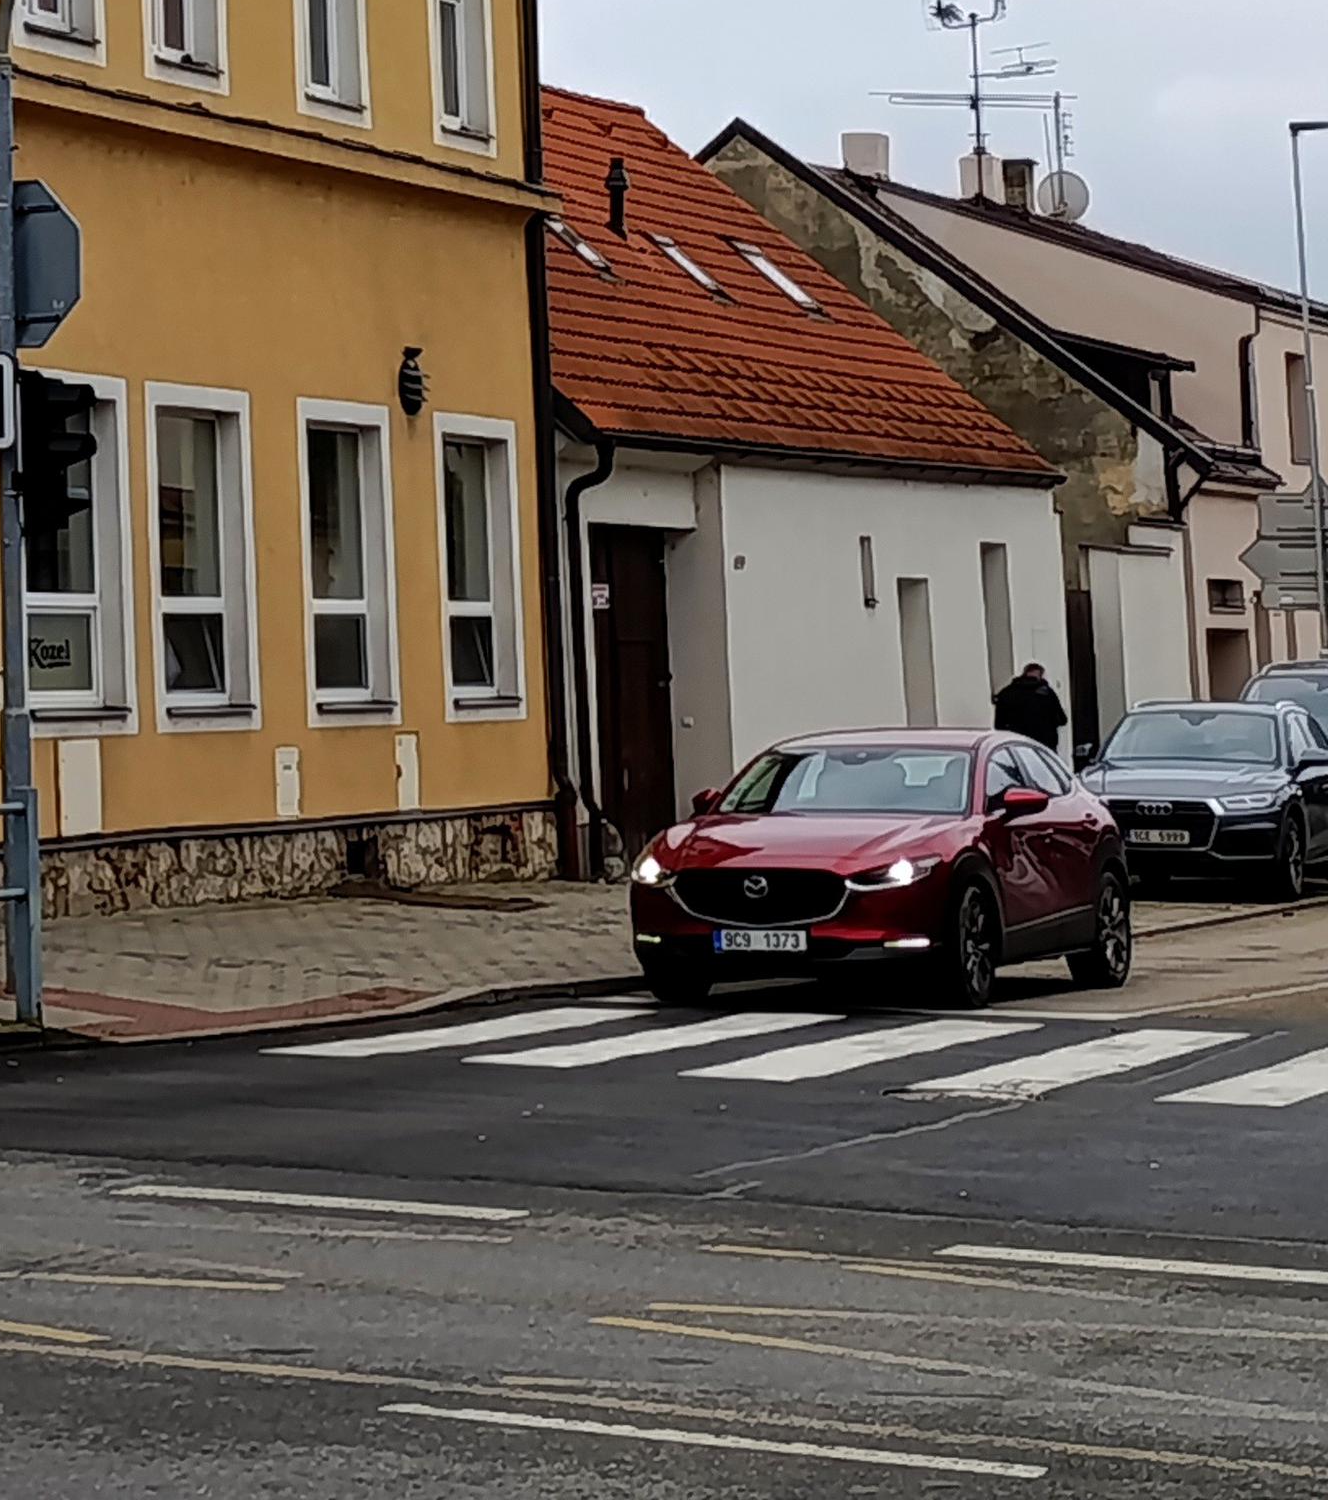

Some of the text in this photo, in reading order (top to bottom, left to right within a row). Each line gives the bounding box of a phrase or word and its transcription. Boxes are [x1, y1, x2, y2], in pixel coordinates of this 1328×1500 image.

[29, 638, 72, 669] Kozel
[725, 932, 800, 948] 9C9 1373
